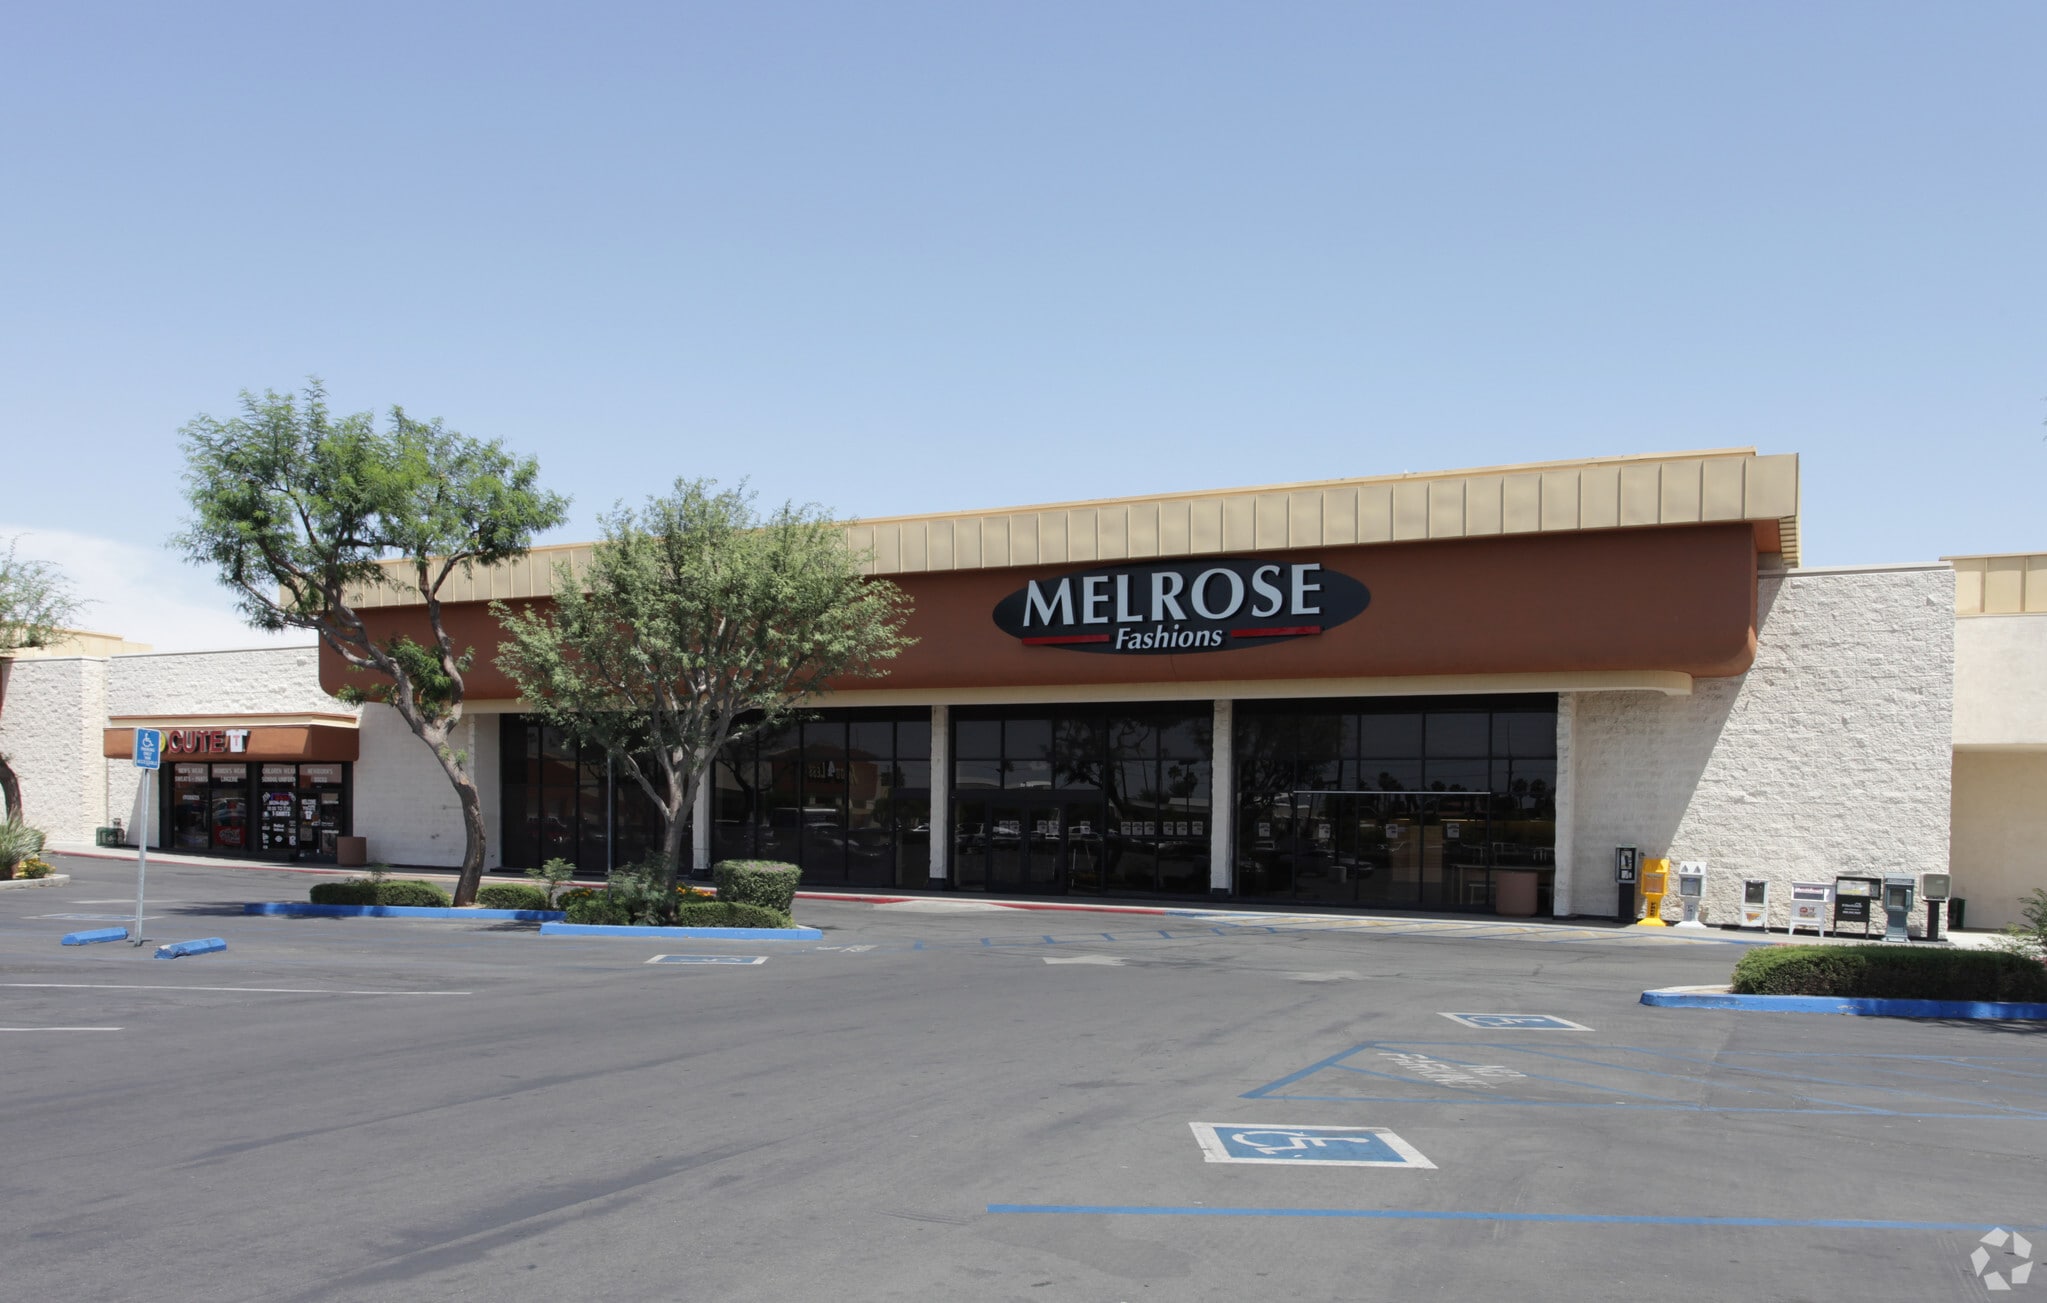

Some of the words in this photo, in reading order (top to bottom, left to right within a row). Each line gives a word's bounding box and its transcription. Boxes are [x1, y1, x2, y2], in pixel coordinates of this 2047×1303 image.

[1023, 563, 1321, 626] MELROSE
[1115, 625, 1223, 650] Fashions
[169, 730, 225, 753] CUTE
[1377, 1052, 1497, 1089] PARKING
